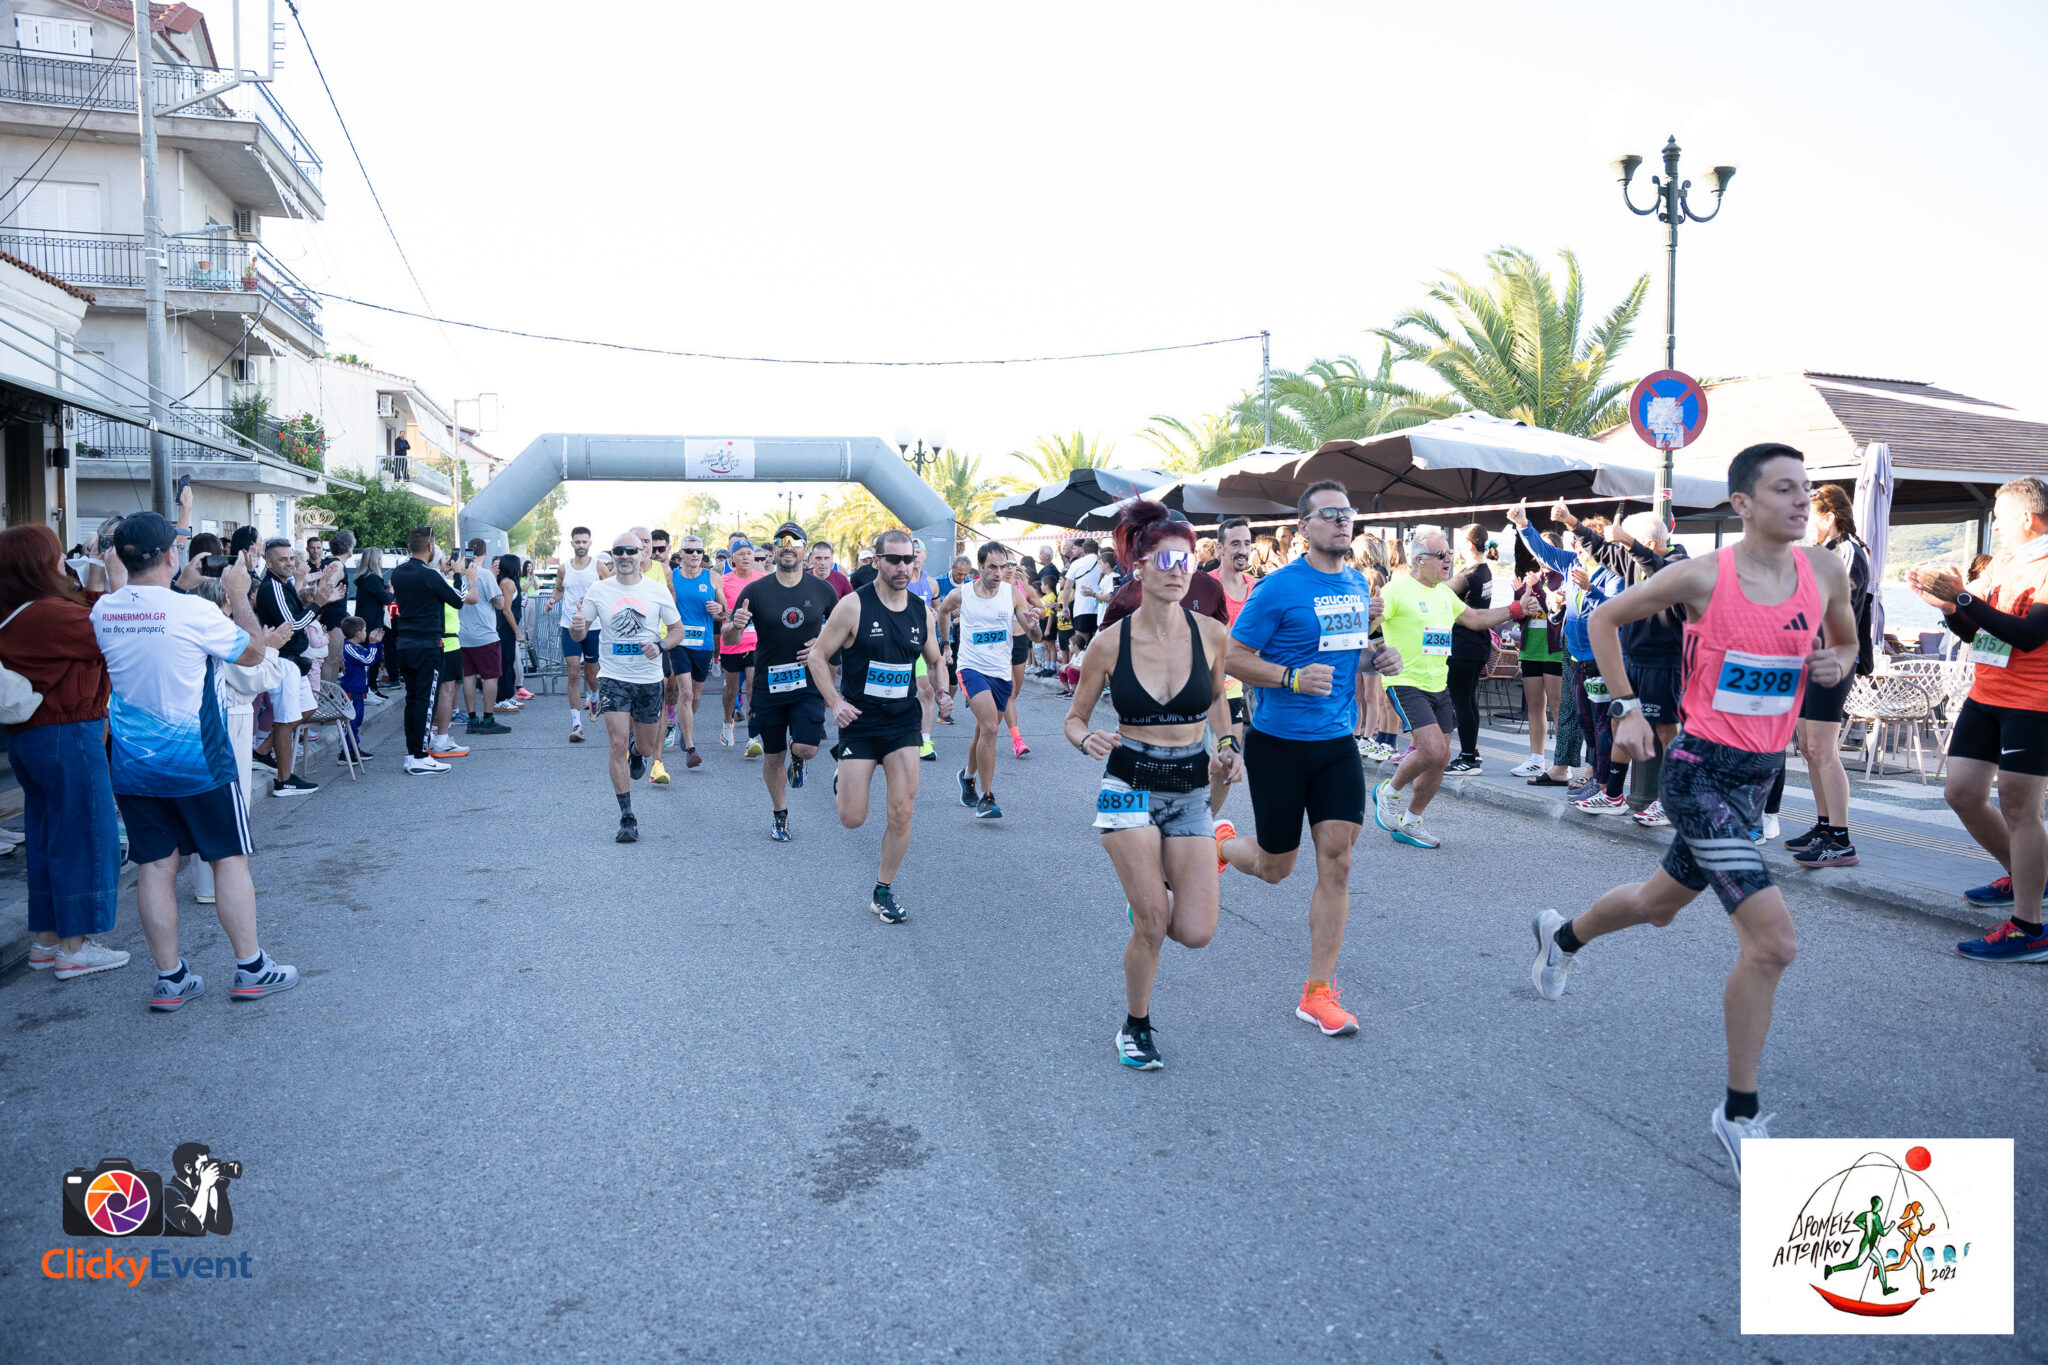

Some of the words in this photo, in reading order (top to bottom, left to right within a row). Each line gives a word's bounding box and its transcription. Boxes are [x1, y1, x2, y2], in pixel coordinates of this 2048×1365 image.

[102, 613, 166, 621] RUNNERMOM.GR
[1323, 612, 1362, 632] 2334
[113, 625, 125, 635] θες
[137, 625, 166, 635] μπορείς
[685, 630, 703, 638] 349
[976, 632, 1004, 643] 2392
[1425, 634, 1450, 645] 2364
[616, 644, 640, 653] 235
[772, 669, 801, 682] 2313
[867, 670, 911, 684] 56900
[1726, 667, 1793, 692] 2398
